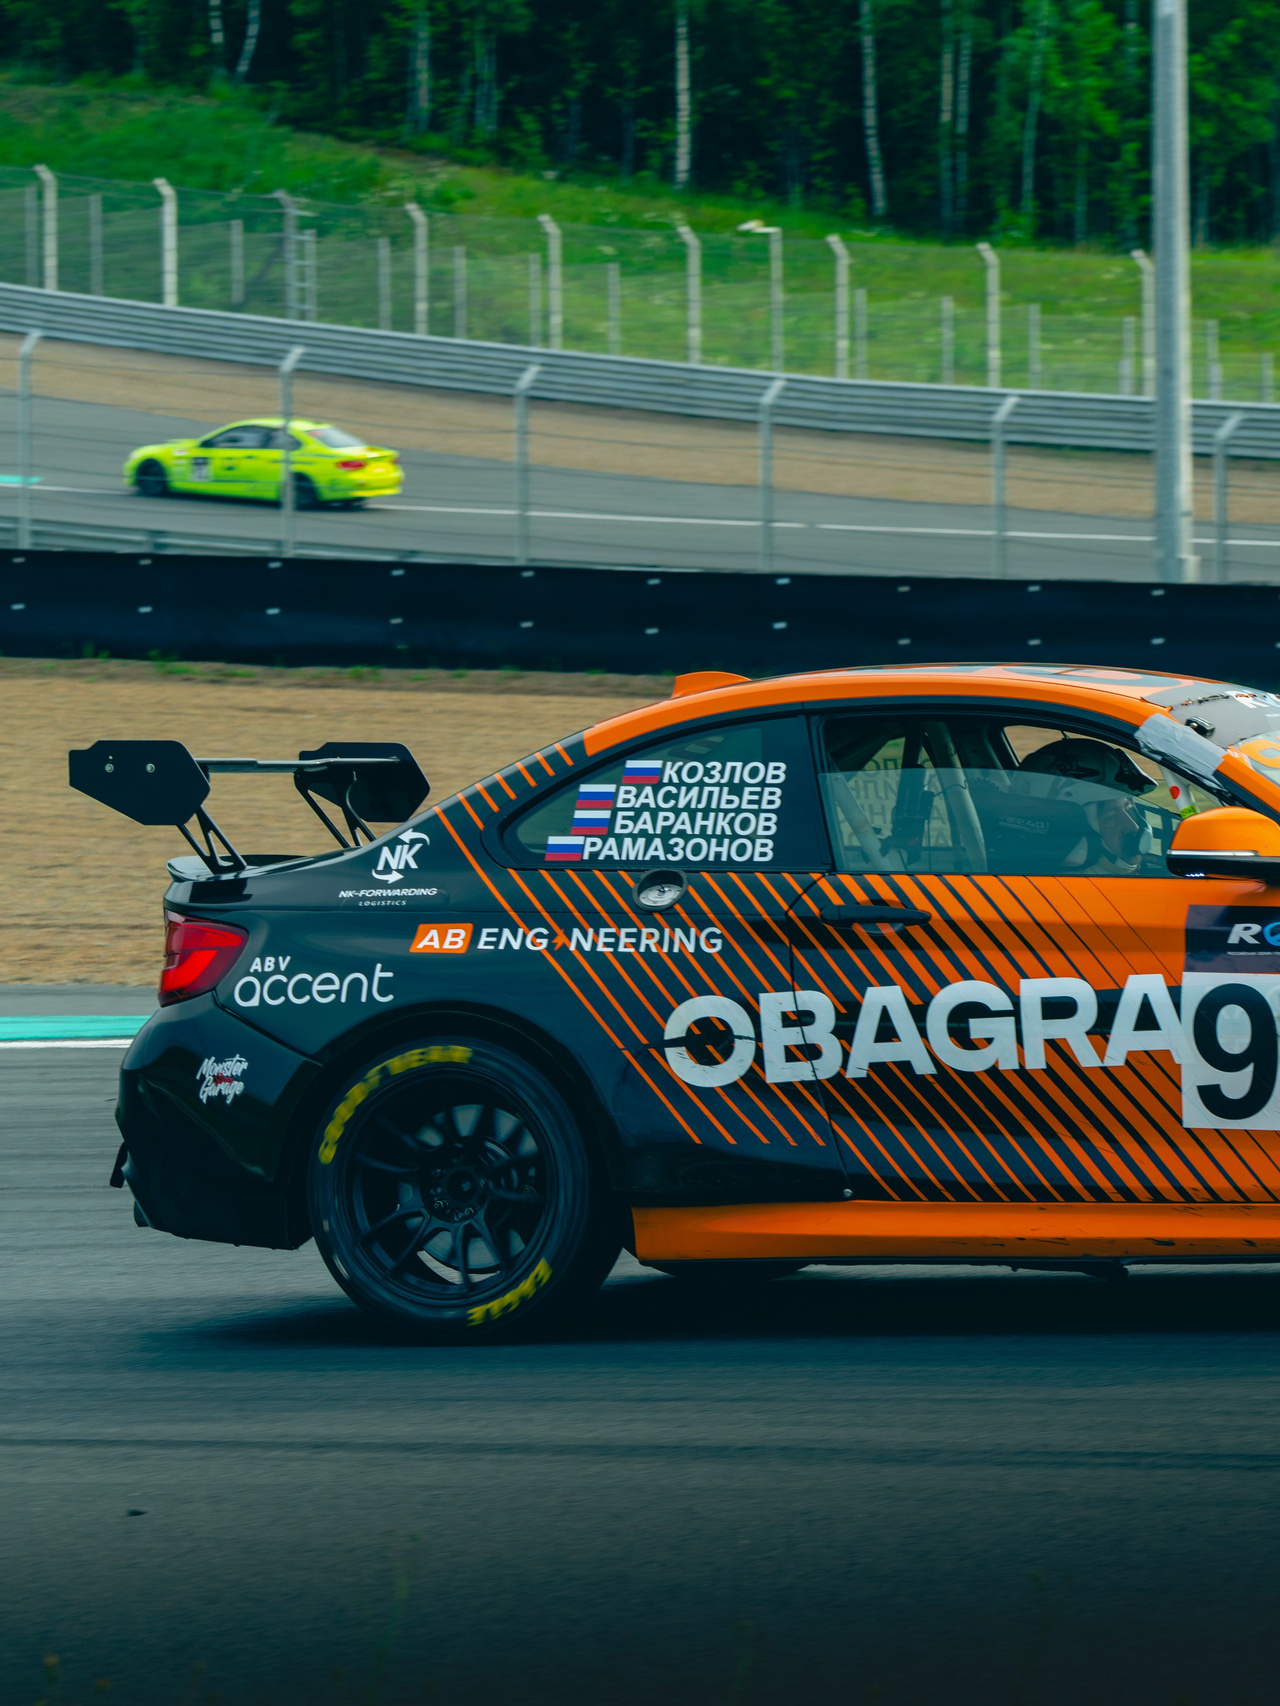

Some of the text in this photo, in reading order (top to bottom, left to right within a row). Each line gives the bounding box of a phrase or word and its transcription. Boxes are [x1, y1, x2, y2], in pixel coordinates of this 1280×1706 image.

[662, 760, 787, 784] КОЗЛОВ
[616, 785, 783, 810] ВАСИЛЬЕВ
[613, 811, 778, 836] БАРАНКОВ
[376, 843, 424, 871] NK
[582, 837, 774, 862] РАМАЗОНОВ
[338, 887, 438, 898] NK-FORWARDING
[416, 926, 724, 954] AB ENGNEERING
[250, 956, 291, 973] ABV
[233, 963, 394, 1008] accent
[663, 973, 1183, 1088] OBAGRA
[196, 1053, 249, 1080] Monster
[199, 1076, 245, 1105] Garage
